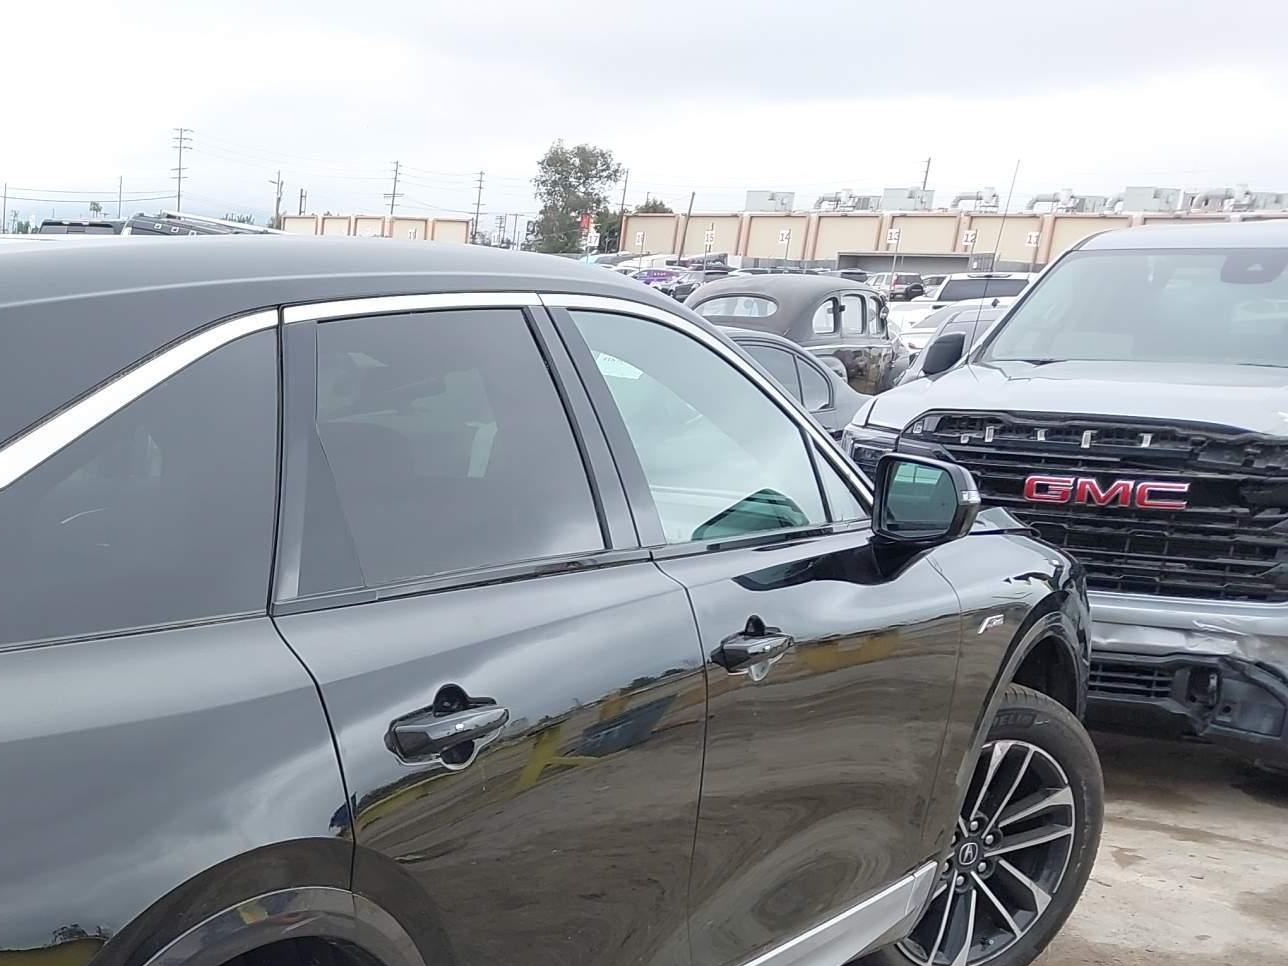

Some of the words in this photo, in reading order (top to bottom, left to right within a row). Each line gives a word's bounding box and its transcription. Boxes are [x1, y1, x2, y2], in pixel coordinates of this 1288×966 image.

[587, 235, 599, 245] 17
[963, 233, 976, 243] 12
[1024, 475, 1191, 510] GMC
